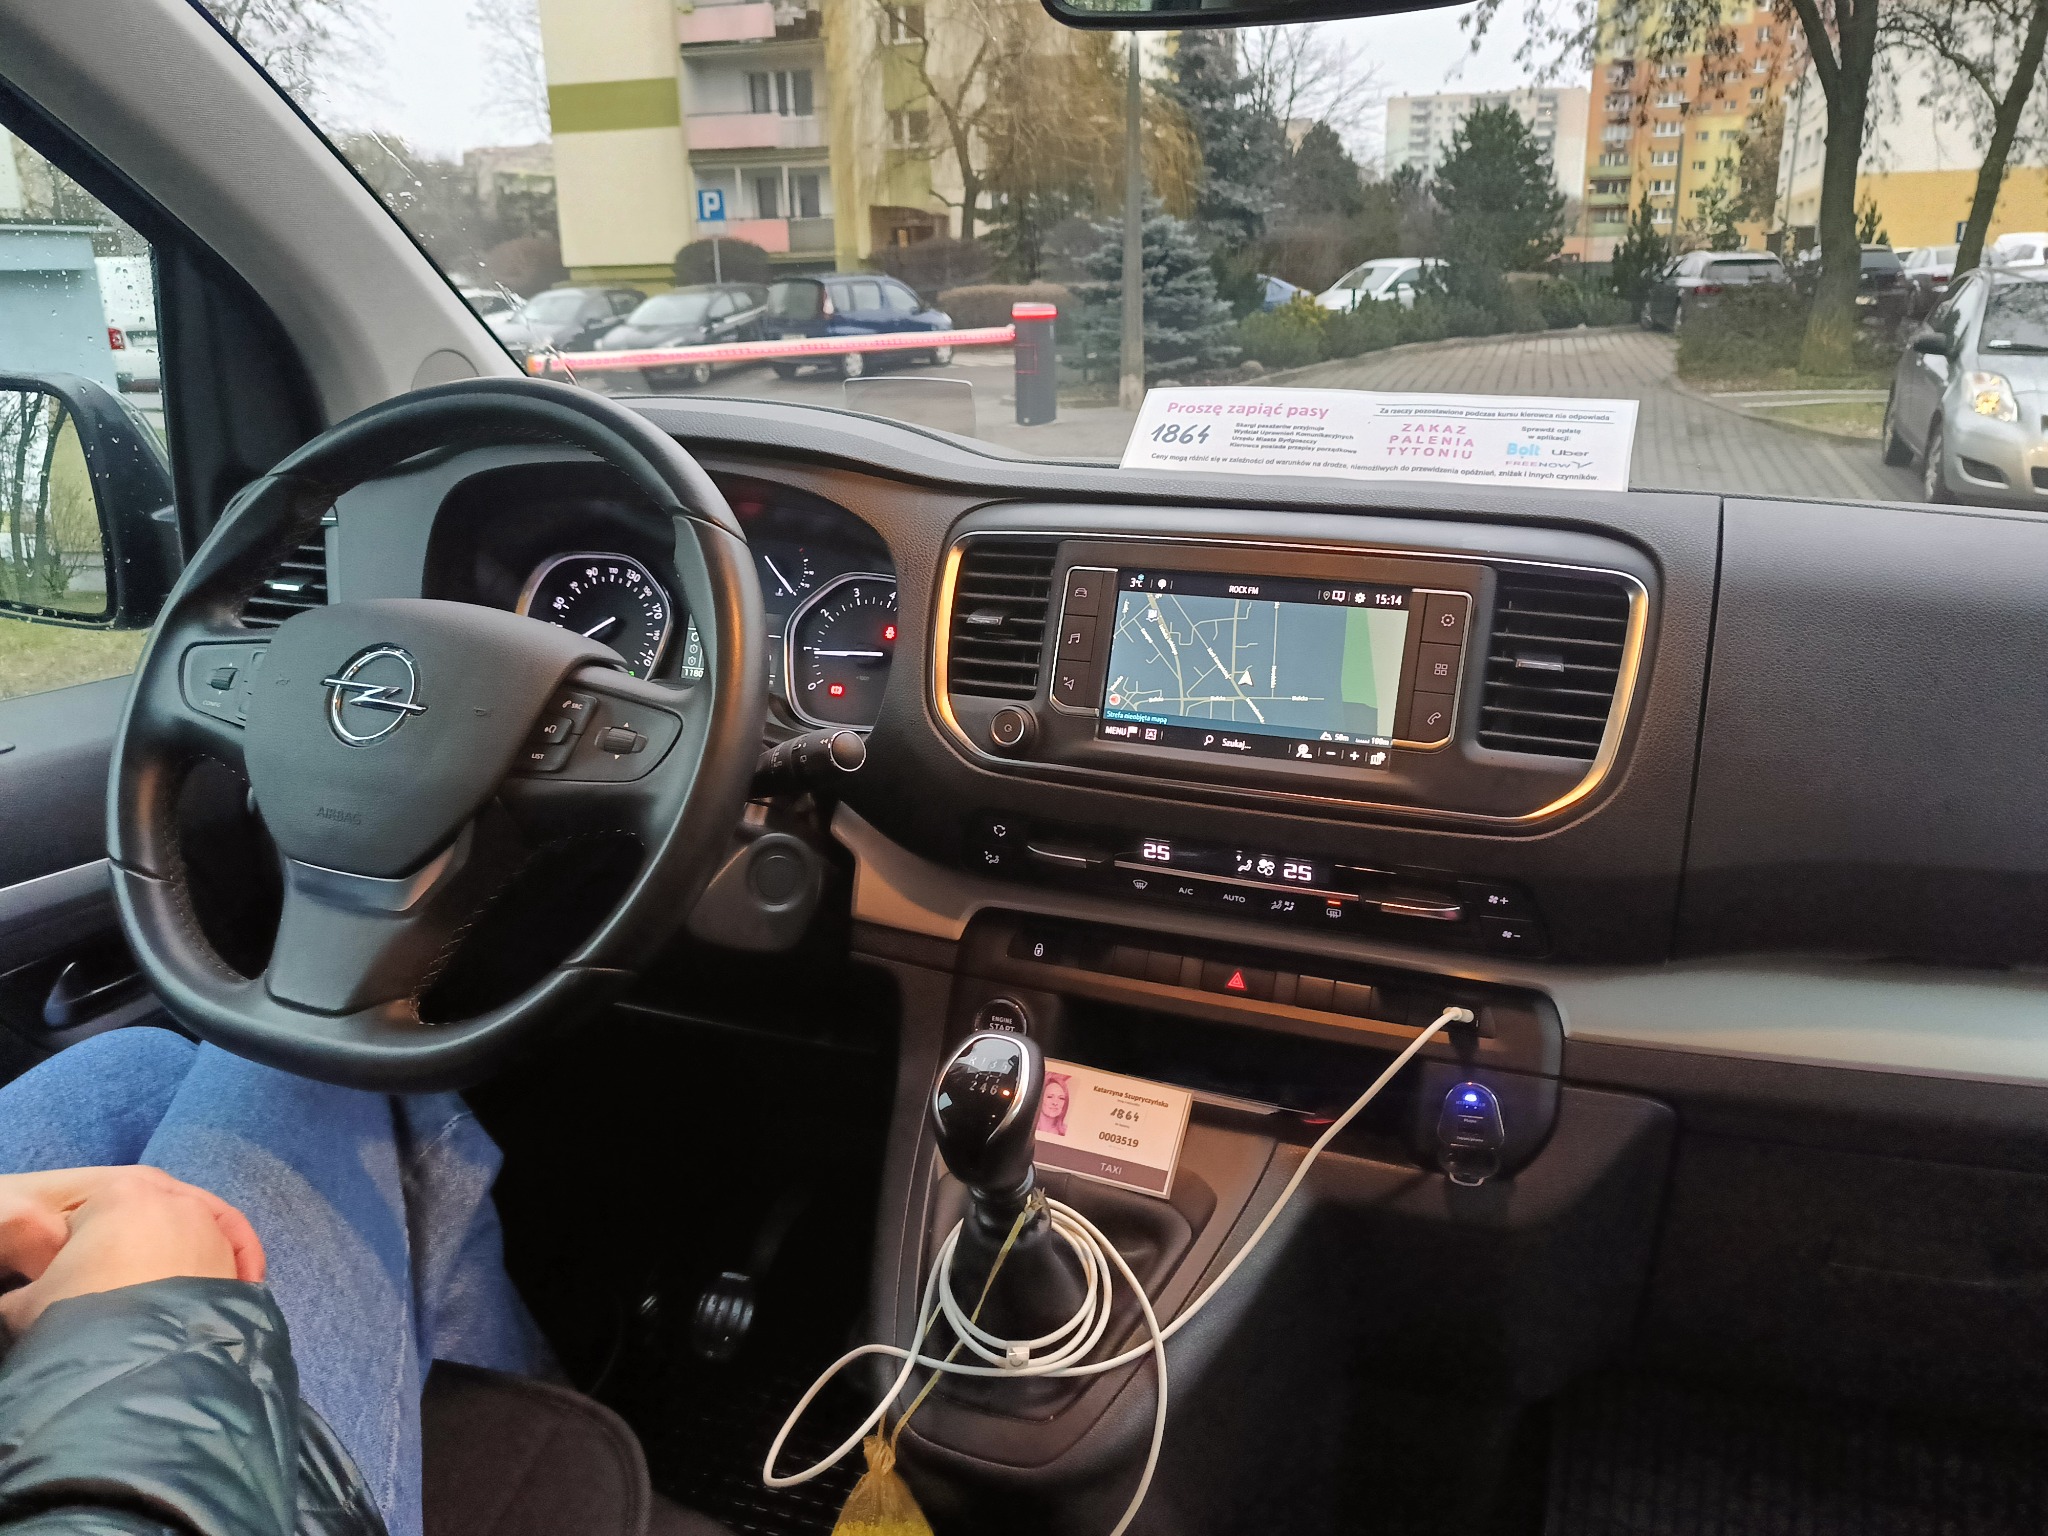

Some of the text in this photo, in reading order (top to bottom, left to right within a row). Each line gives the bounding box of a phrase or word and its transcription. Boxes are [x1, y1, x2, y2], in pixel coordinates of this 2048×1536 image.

[703, 191, 720, 218] P
[1167, 402, 1329, 419] Proszę zapiąć pasy
[1568, 413, 1610, 421] odpowiada
[1151, 423, 1210, 445] 1864
[1401, 423, 1467, 435] ZAKAZ
[1278, 437, 1318, 445] Bydgoszczy
[1295, 432, 1354, 440] Komunikacyjnych
[1388, 435, 1474, 447] PALENIA
[1386, 447, 1472, 460] TYTONIU
[1506, 442, 1541, 456] Bolt
[1551, 449, 1589, 457] Uber
[1229, 456, 1264, 464] zależności
[1276, 458, 1311, 466] warunków
[1322, 461, 1349, 470] drodze,
[1350, 464, 1398, 472] niemożliwych
[1556, 473, 1600, 481] czynników.
[585, 567, 599, 578] 90
[626, 569, 641, 582] 130
[853, 588, 860, 597] 3
[889, 591, 897, 601] 4
[1229, 585, 1259, 595] ROCK FM
[552, 596, 565, 610] 50
[1375, 594, 1402, 606] 15:14
[652, 603, 663, 620] 170
[820, 608, 830, 617] 2
[643, 649, 655, 667] 210
[807, 683, 817, 691] 0
[1107, 711, 1124, 719] Strefa
[1105, 726, 1126, 735] MENU
[317, 807, 361, 825] AIRBAG
[1143, 843, 1170, 861] 25
[1283, 863, 1312, 882] 25
[1178, 887, 1194, 895] A/C
[1223, 893, 1246, 903] AUTO
[991, 1015, 1013, 1024] ENGINE
[989, 1023, 1016, 1032] START
[969, 1080, 999, 1096] 2 4 6
[1093, 1085, 1124, 1098] Katarzyna
[1124, 1092, 1169, 1108] Szupryczyńska
[1110, 1107, 1140, 1122] 1864
[1098, 1131, 1139, 1148] 0003519
[1100, 1162, 1122, 1175] TAXI
